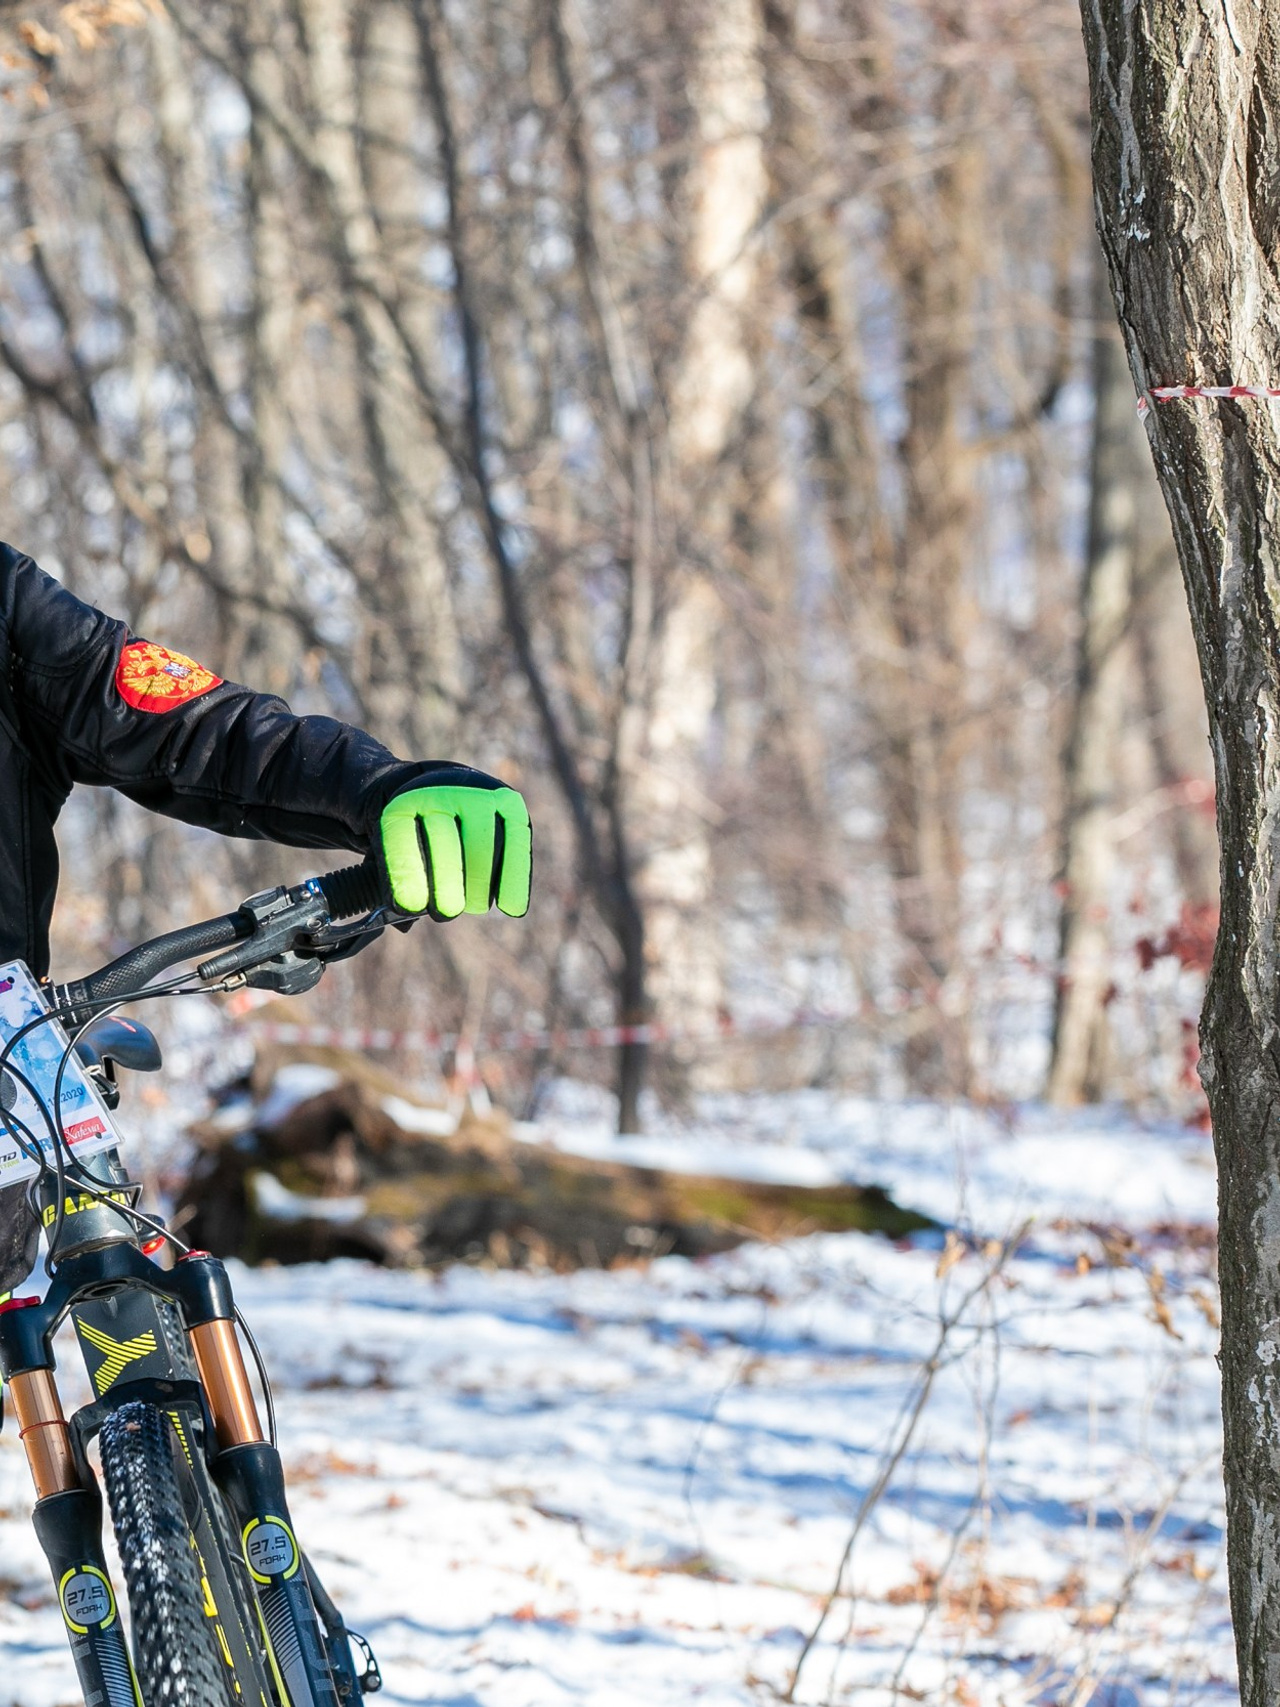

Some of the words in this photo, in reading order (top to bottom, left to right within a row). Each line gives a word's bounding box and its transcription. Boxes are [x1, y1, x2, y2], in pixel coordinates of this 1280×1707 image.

[250, 1536, 286, 1556] 27.5
[259, 1553, 286, 1567] FORK
[67, 1585, 103, 1606] 27.5
[76, 1603, 103, 1617] FORK
